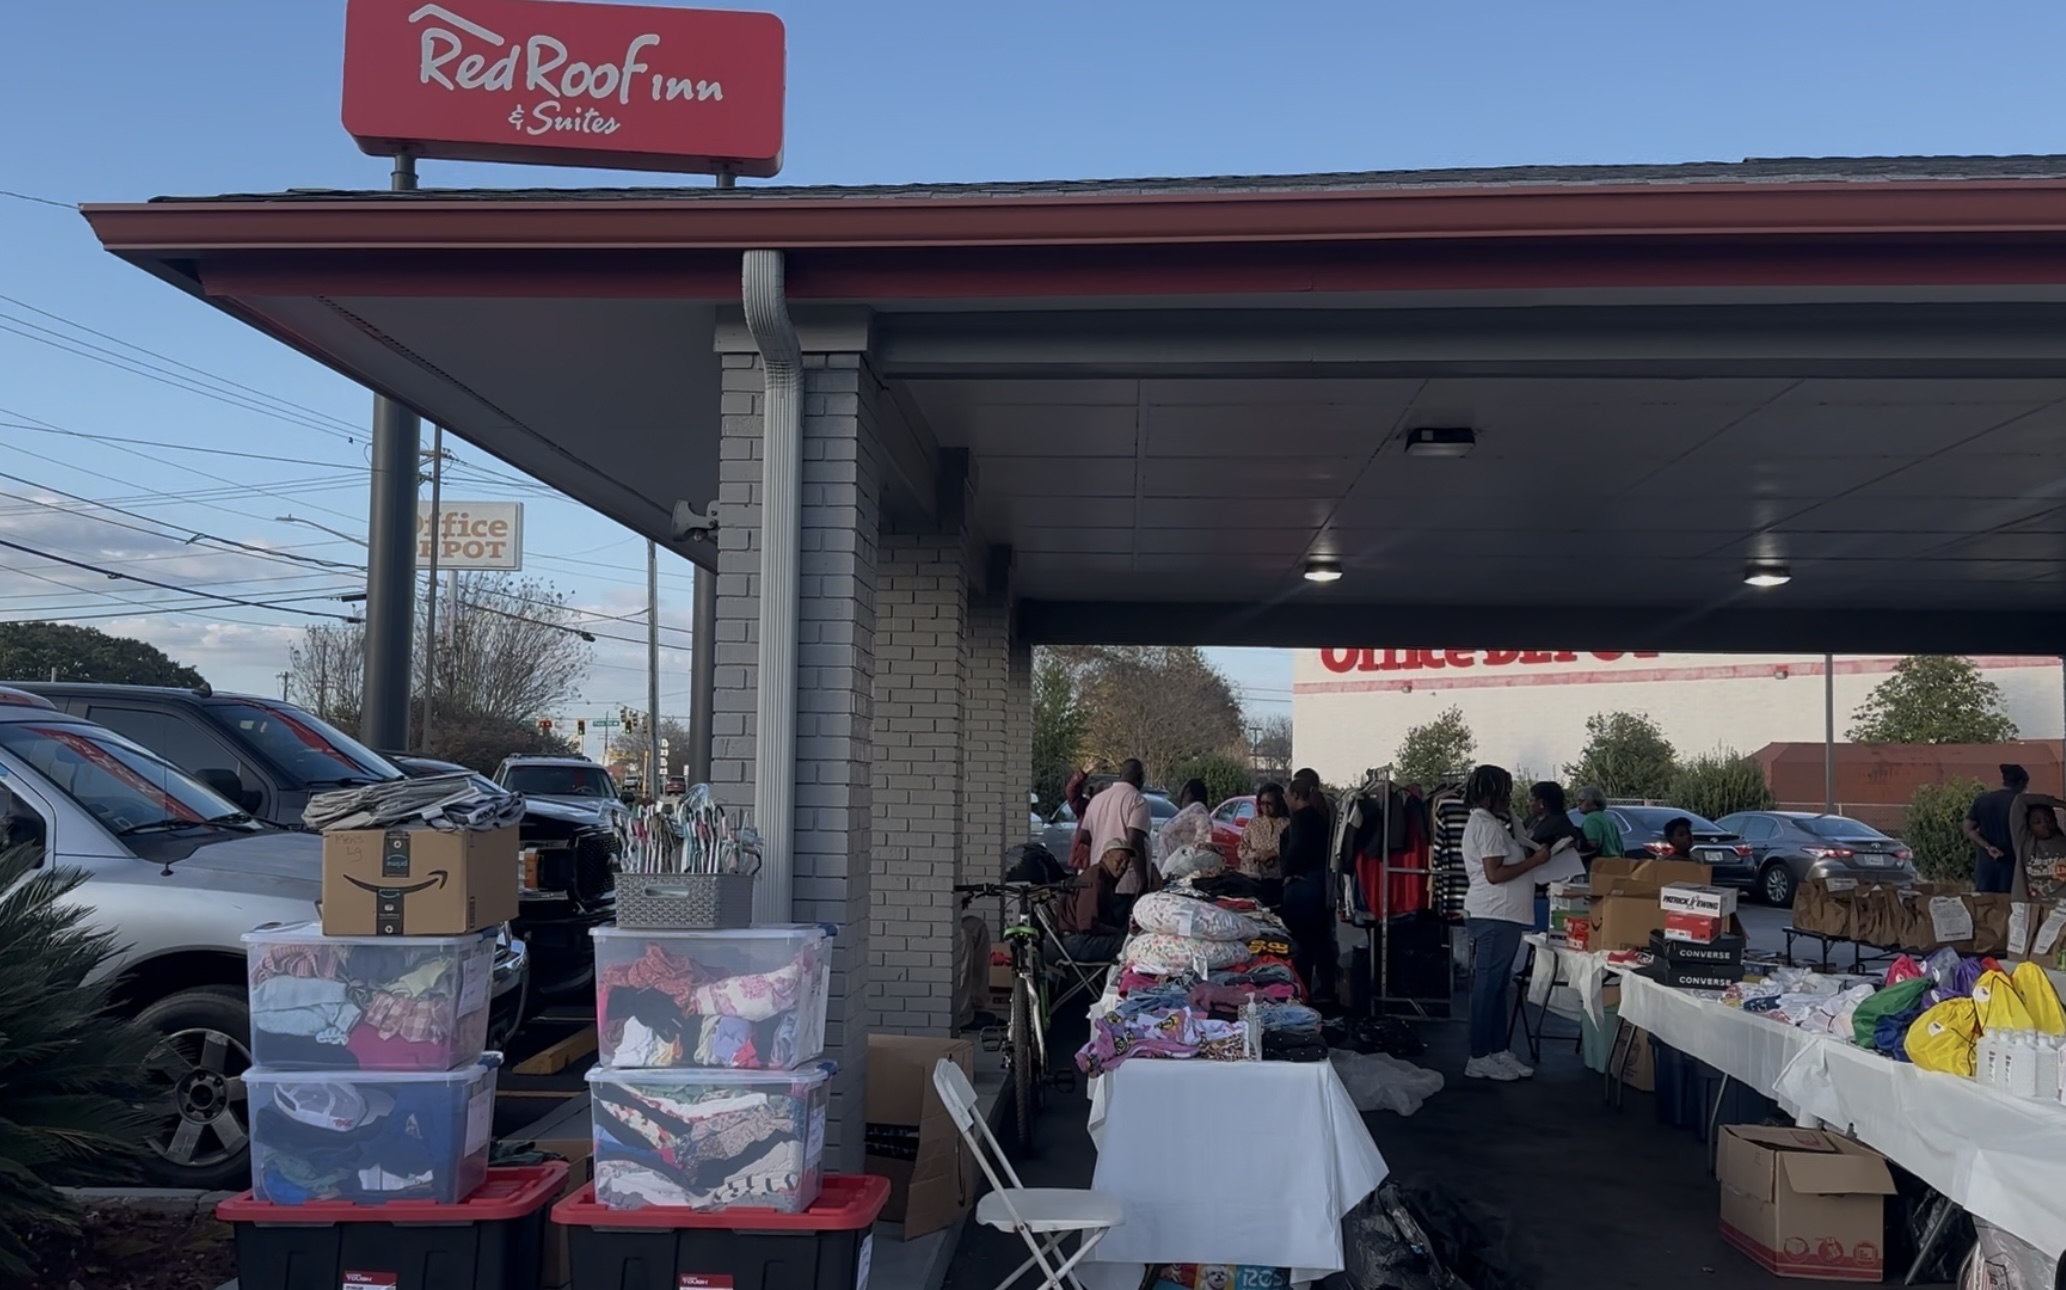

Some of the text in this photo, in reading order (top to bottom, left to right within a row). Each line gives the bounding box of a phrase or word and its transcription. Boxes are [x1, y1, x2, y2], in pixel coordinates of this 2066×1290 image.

[508, 101, 621, 135] & Suites
[1662, 895, 1719, 910] PATRICK EWING
[1679, 949, 1731, 960] CONVERSE
[1679, 976, 1732, 987] CONVERSE
